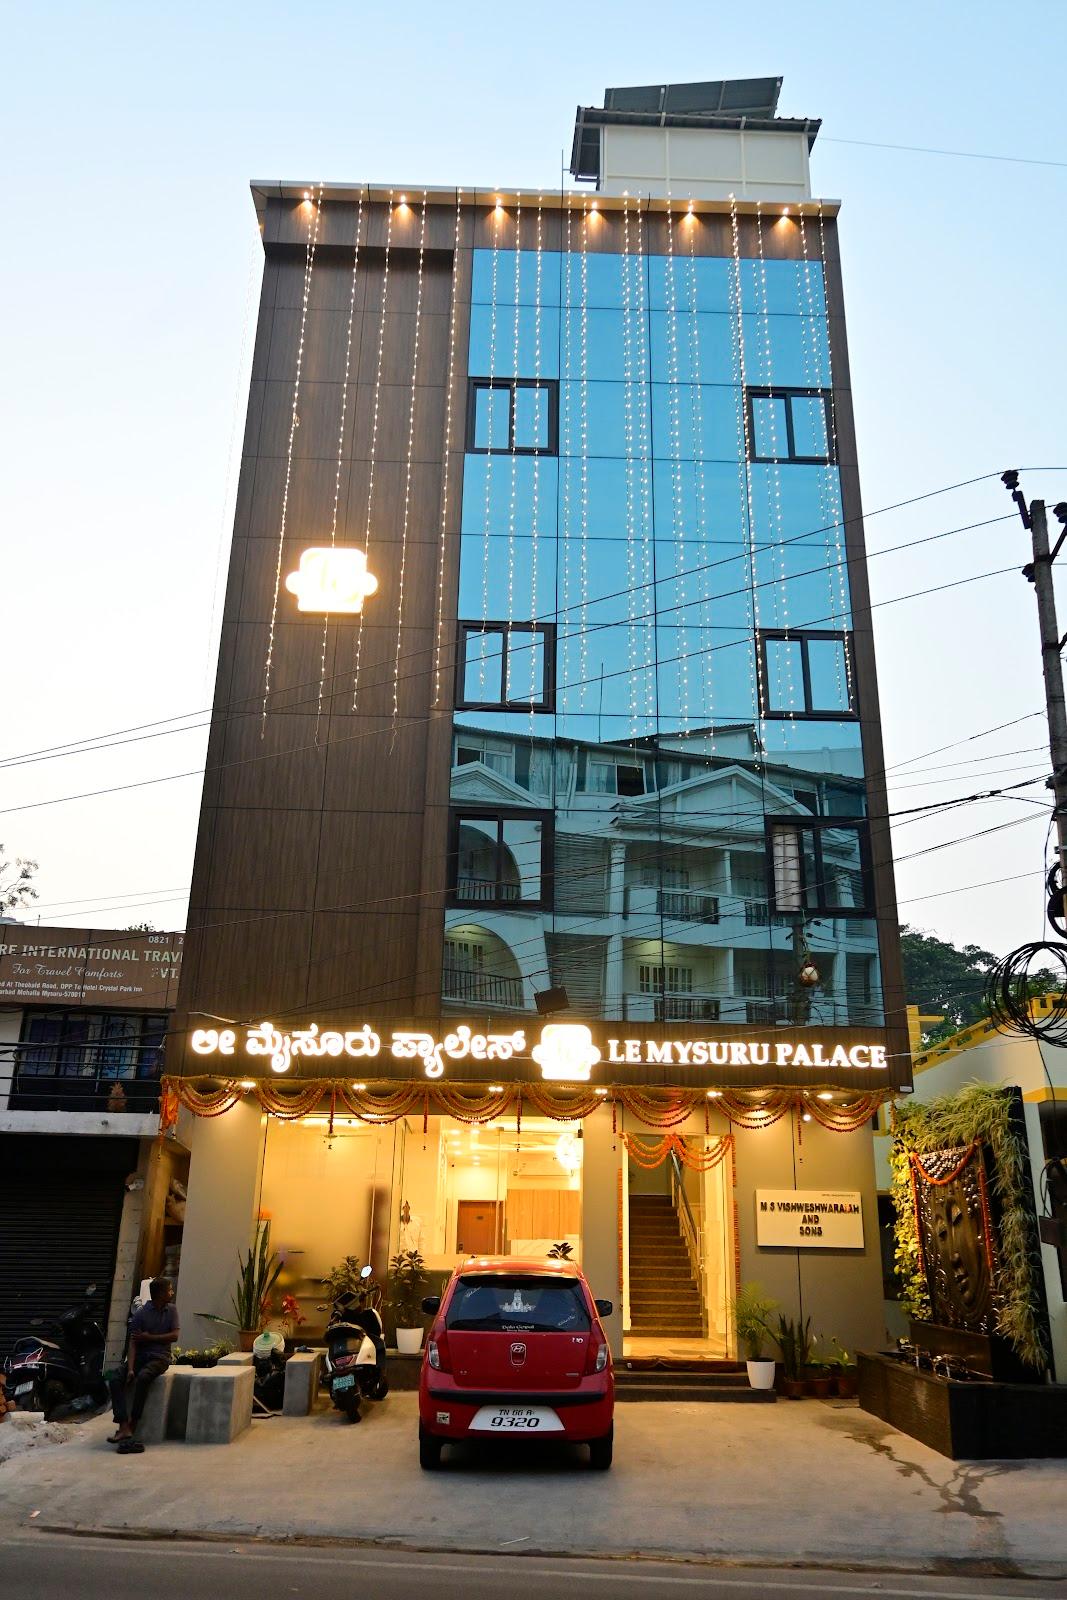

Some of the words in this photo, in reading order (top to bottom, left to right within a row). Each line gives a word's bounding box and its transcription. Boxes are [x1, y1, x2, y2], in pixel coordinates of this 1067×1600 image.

[149, 936, 169, 944] 0821
[21, 945, 139, 961] INTERNATIONAL
[12, 963, 33, 975] For
[35, 963, 72, 977] Travel
[74, 966, 124, 981] Comforts
[15, 981, 41, 989] Theobald
[99, 984, 119, 993] Crystal
[608, 1039, 641, 1063] LE
[645, 1041, 769, 1066] MYSURU
[774, 1043, 887, 1068] PALACE
[760, 1202, 767, 1211] M
[769, 1202, 775, 1211] S
[802, 1214, 819, 1225] AND
[799, 1226, 823, 1237] SONS
[490, 1416, 540, 1428] 9320
